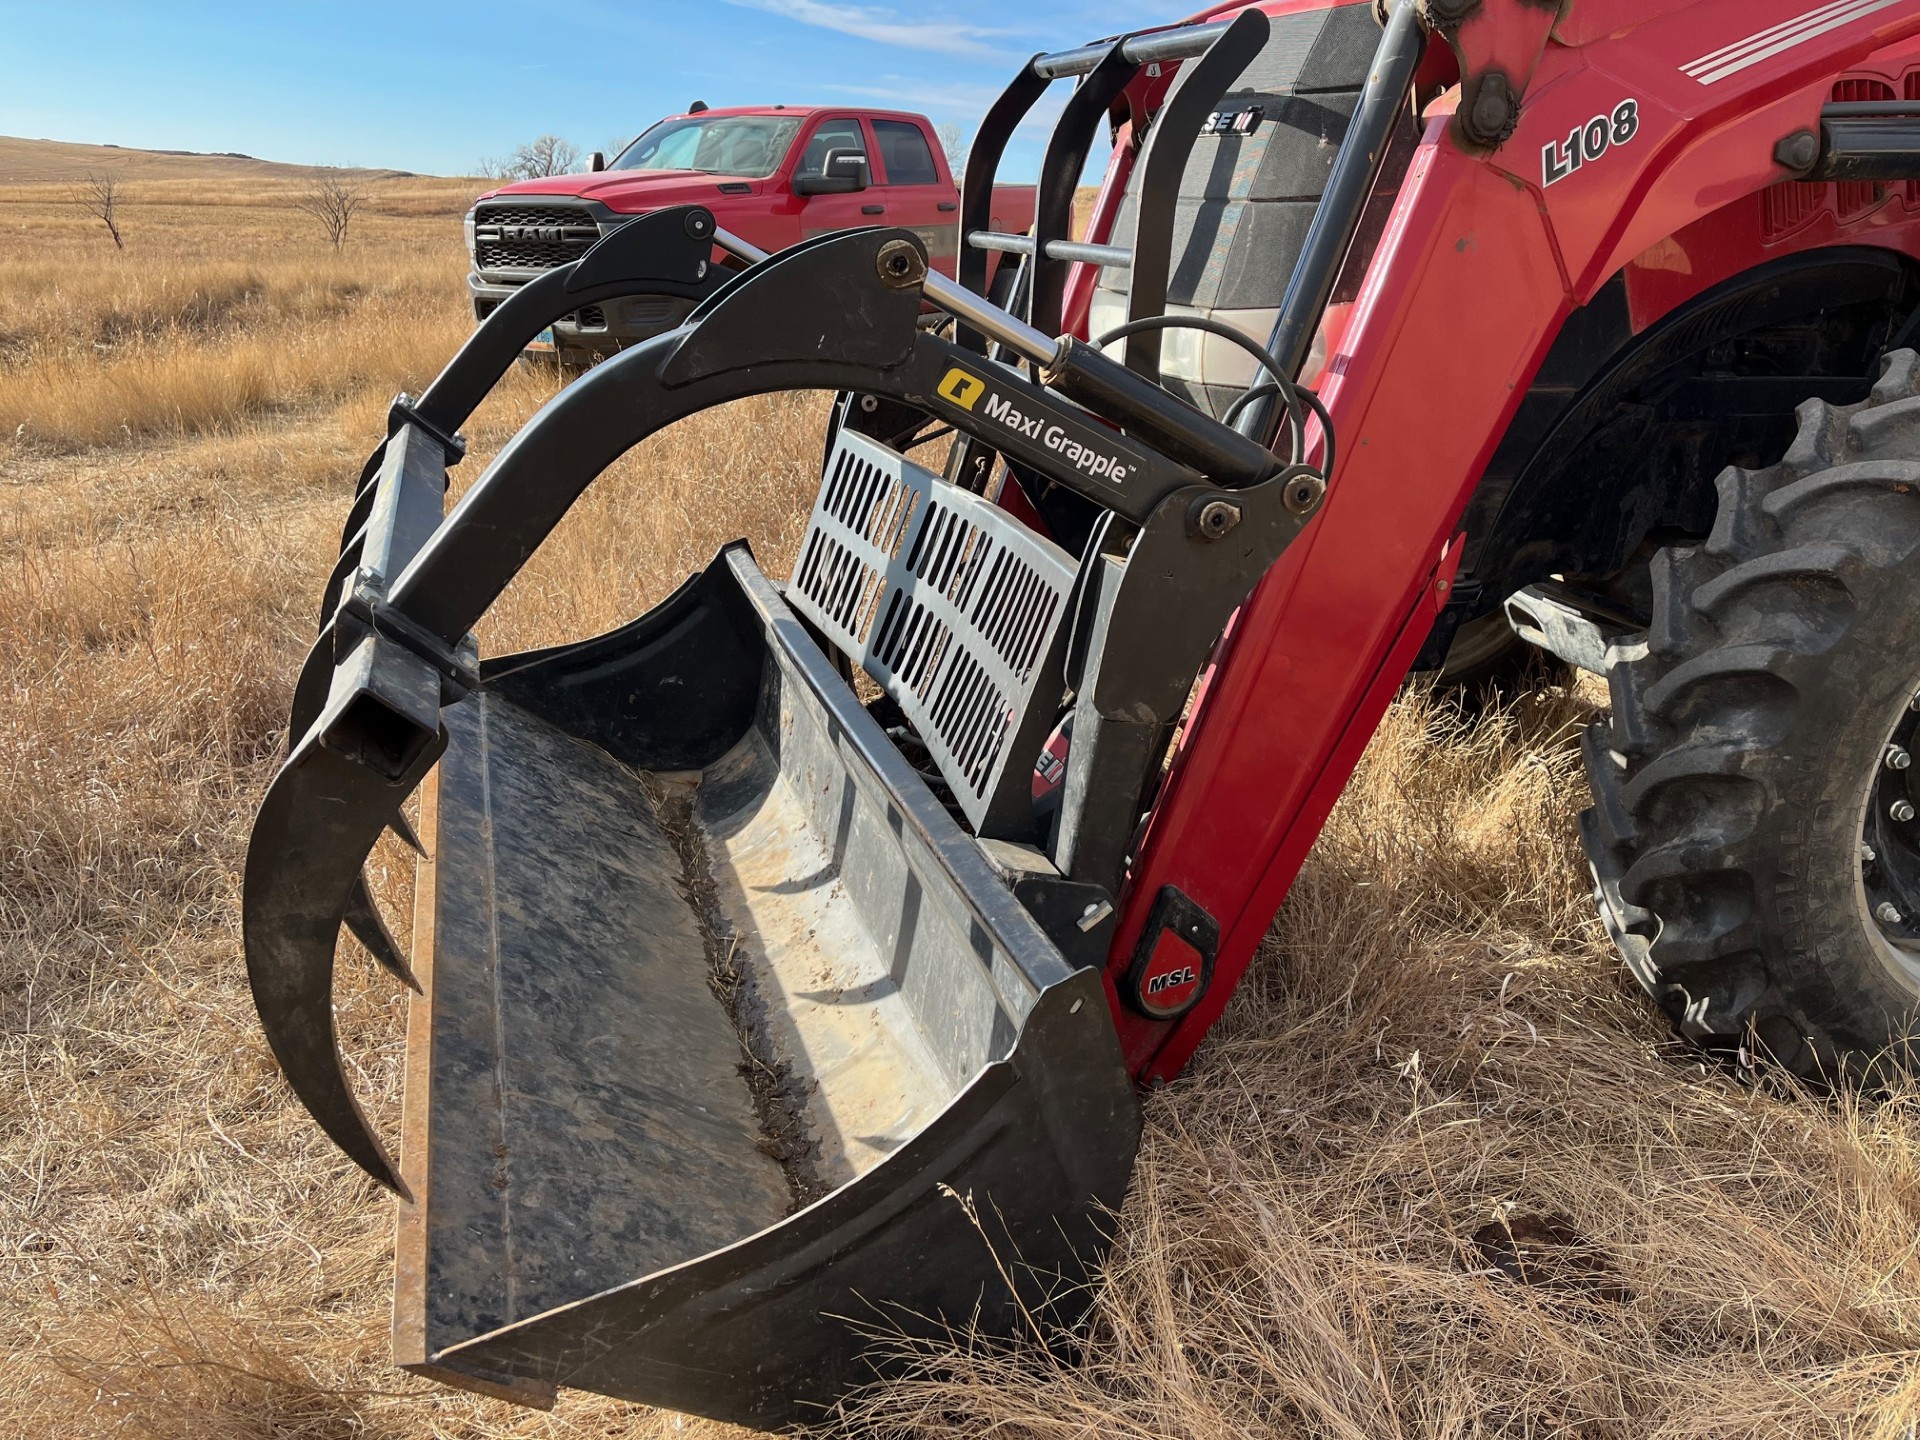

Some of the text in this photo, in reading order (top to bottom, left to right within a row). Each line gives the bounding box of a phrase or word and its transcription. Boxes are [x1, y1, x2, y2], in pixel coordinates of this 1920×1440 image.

[1541, 97, 1640, 189] L108
[503, 227, 562, 241] RAM
[983, 391, 1045, 440] Maxi
[1147, 966, 1196, 995] MSL
